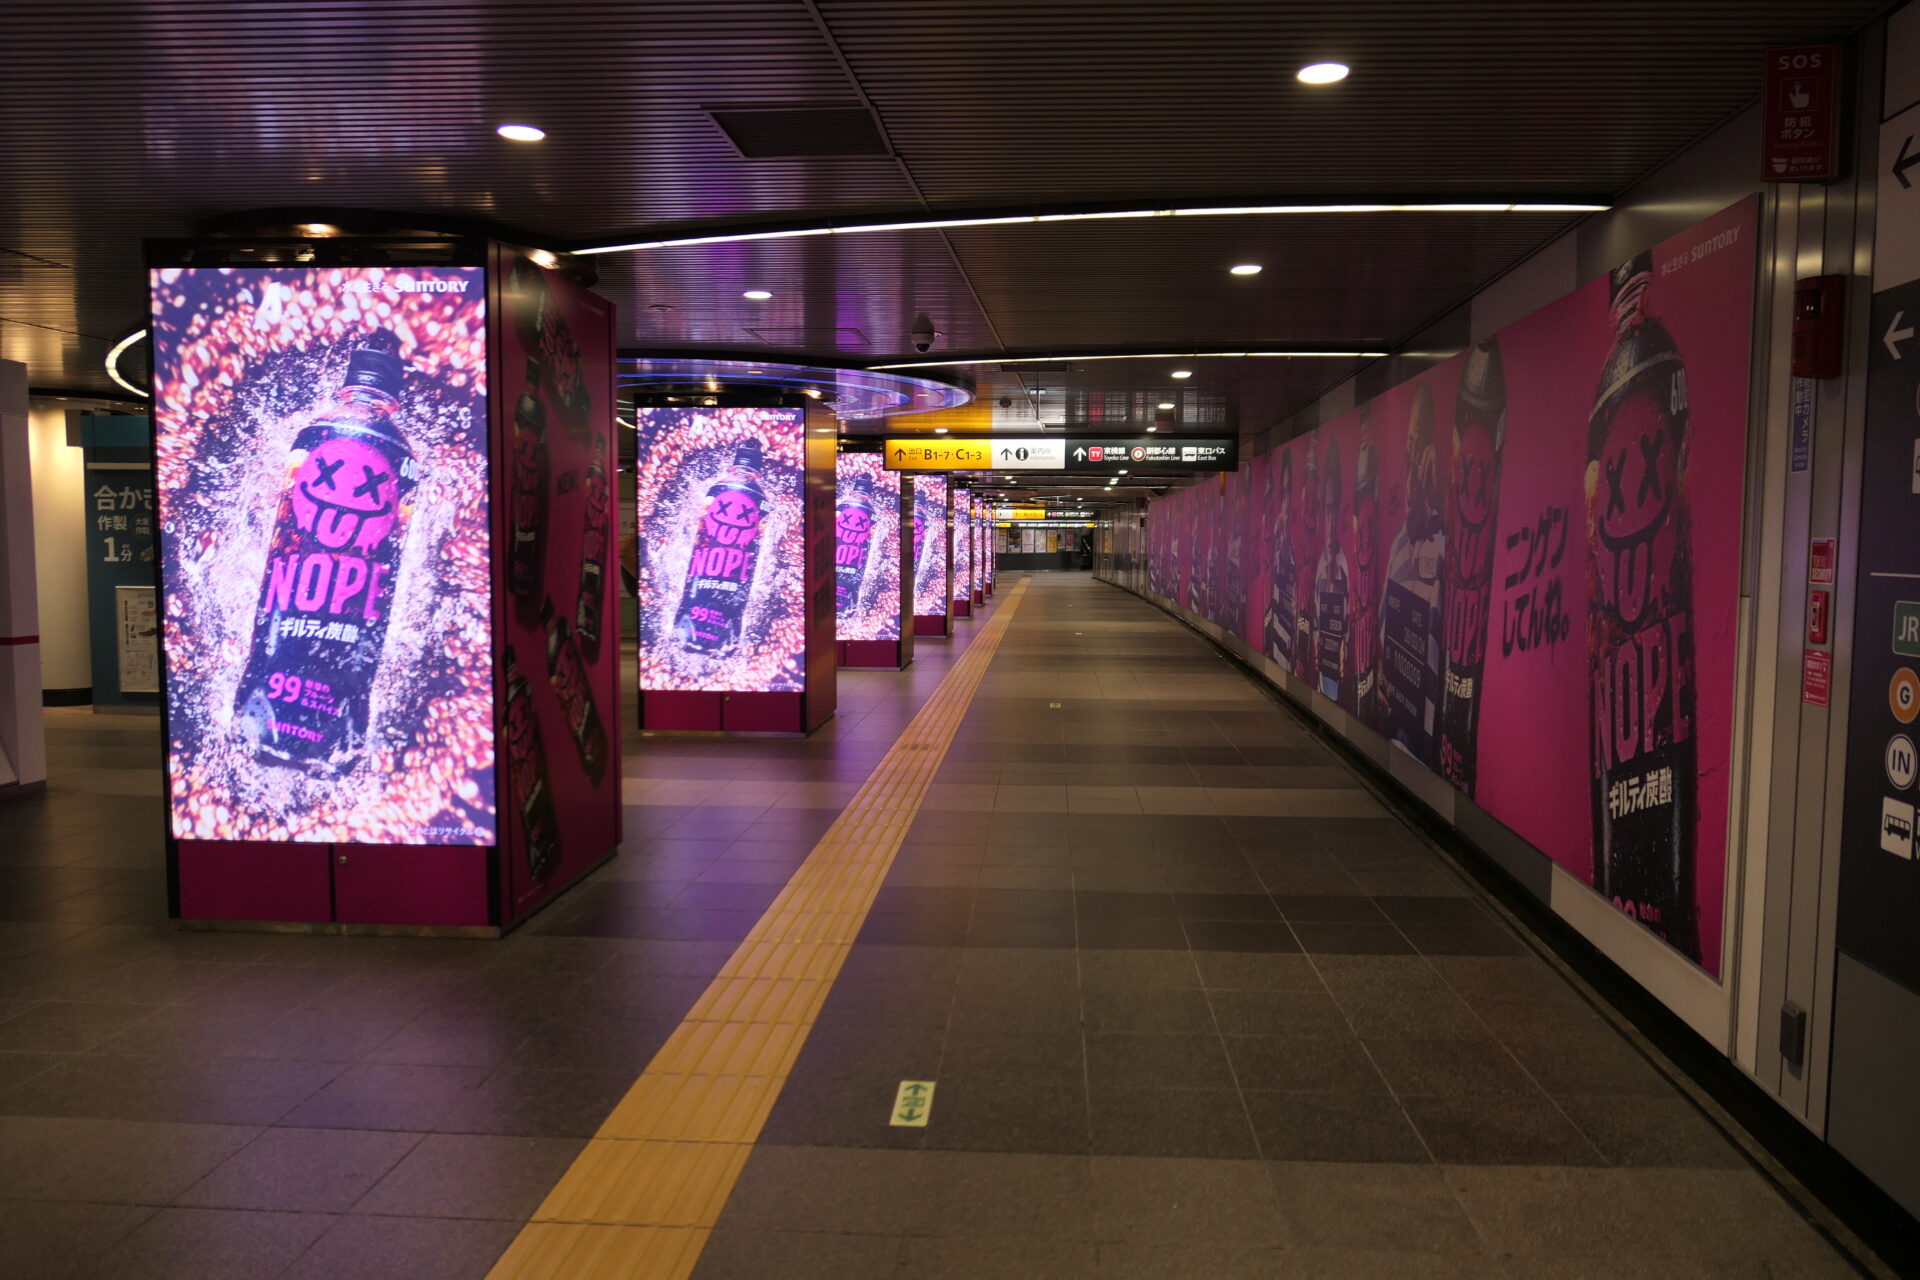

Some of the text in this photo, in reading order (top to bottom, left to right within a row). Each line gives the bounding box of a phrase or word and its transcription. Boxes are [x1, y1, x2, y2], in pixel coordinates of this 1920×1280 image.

[1778, 53, 1822, 71] SOS
[1691, 225, 1741, 263] SUNTORY
[395, 280, 469, 293] SUNTORY
[908, 447, 923, 455] 出口
[1104, 447, 1126, 455] 東横線
[1197, 447, 1226, 455] 東口バス
[97, 514, 128, 531] 作製
[690, 547, 755, 581] NOPE
[836, 545, 864, 567] OPE
[264, 553, 390, 620] NOPE
[691, 605, 709, 622] 99
[279, 616, 360, 643] ギルティ炭酸
[1898, 615, 1919, 643] JR
[267, 672, 302, 703] 99
[1593, 611, 1690, 780] NOPE
[1900, 686, 1911, 705] G
[1892, 749, 1911, 775] IN
[1609, 765, 1673, 821] ギルティ炭酸
